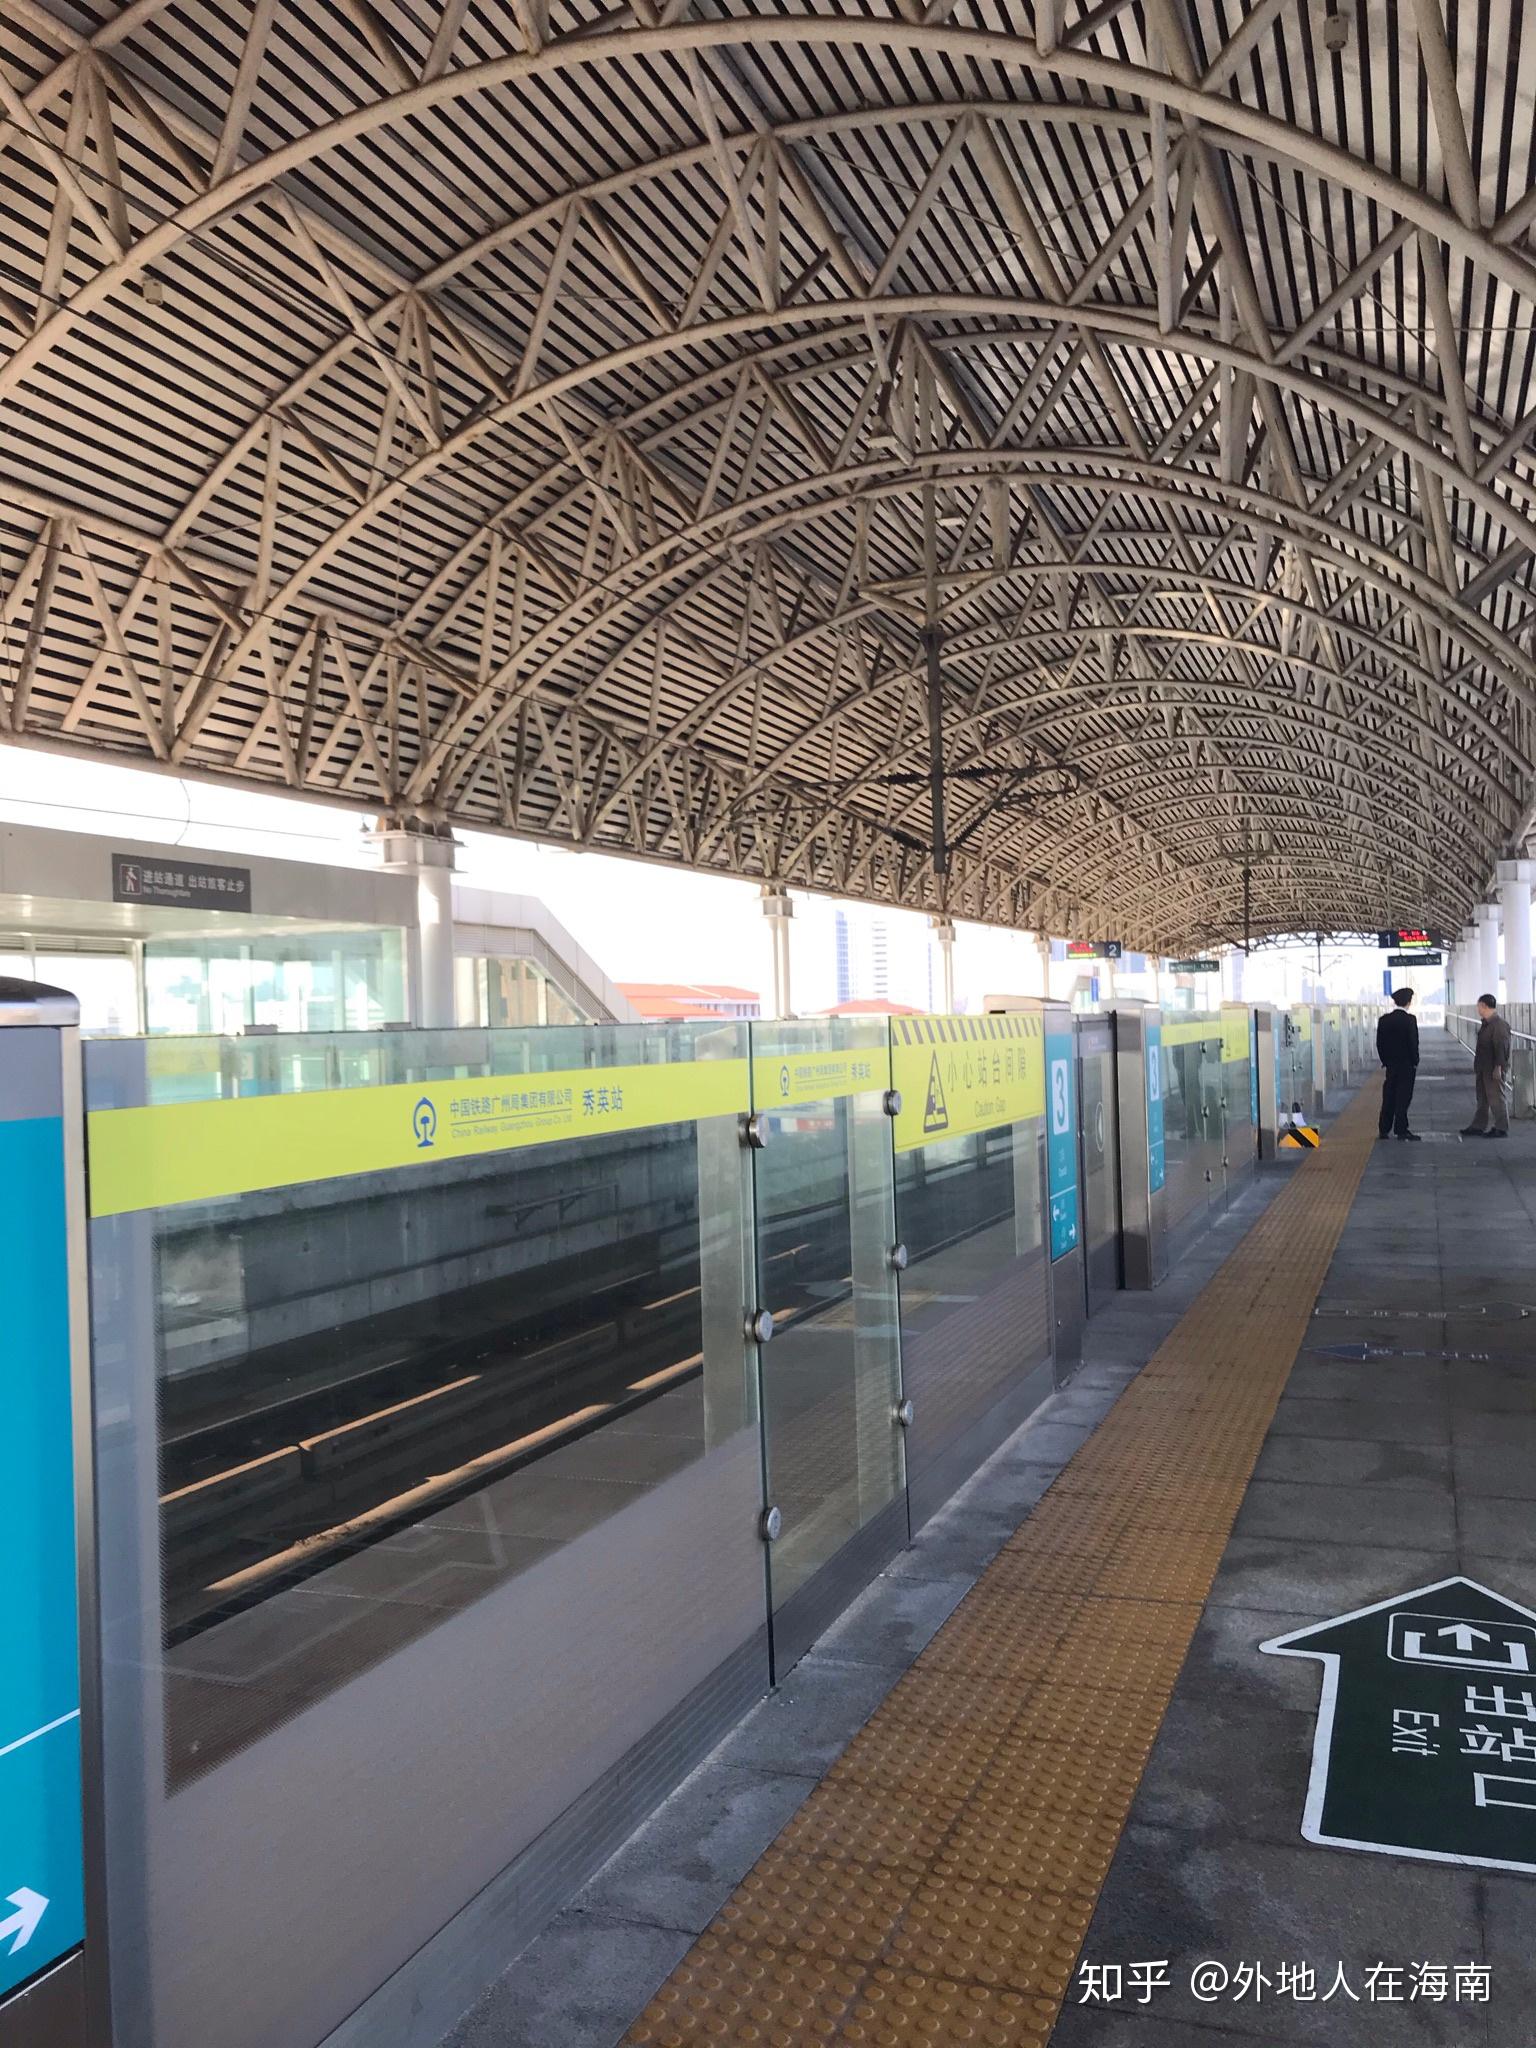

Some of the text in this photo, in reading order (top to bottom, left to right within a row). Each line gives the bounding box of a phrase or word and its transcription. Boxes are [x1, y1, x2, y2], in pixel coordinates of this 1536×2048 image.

[143, 870, 245, 893] 进站通道 出站旅客止步
[1108, 943, 1117, 957] 2
[1385, 934, 1391, 946] 1
[947, 1047, 1027, 1092] 小心站台间隙
[1151, 1050, 1158, 1096] 3
[450, 1085, 623, 1118] 中国铁路广州局集团有限公司 秀英站
[1055, 1067, 1066, 1128] 3
[1391, 1708, 1441, 1755] Exit
[1459, 1685, 1536, 1811] 出站口
